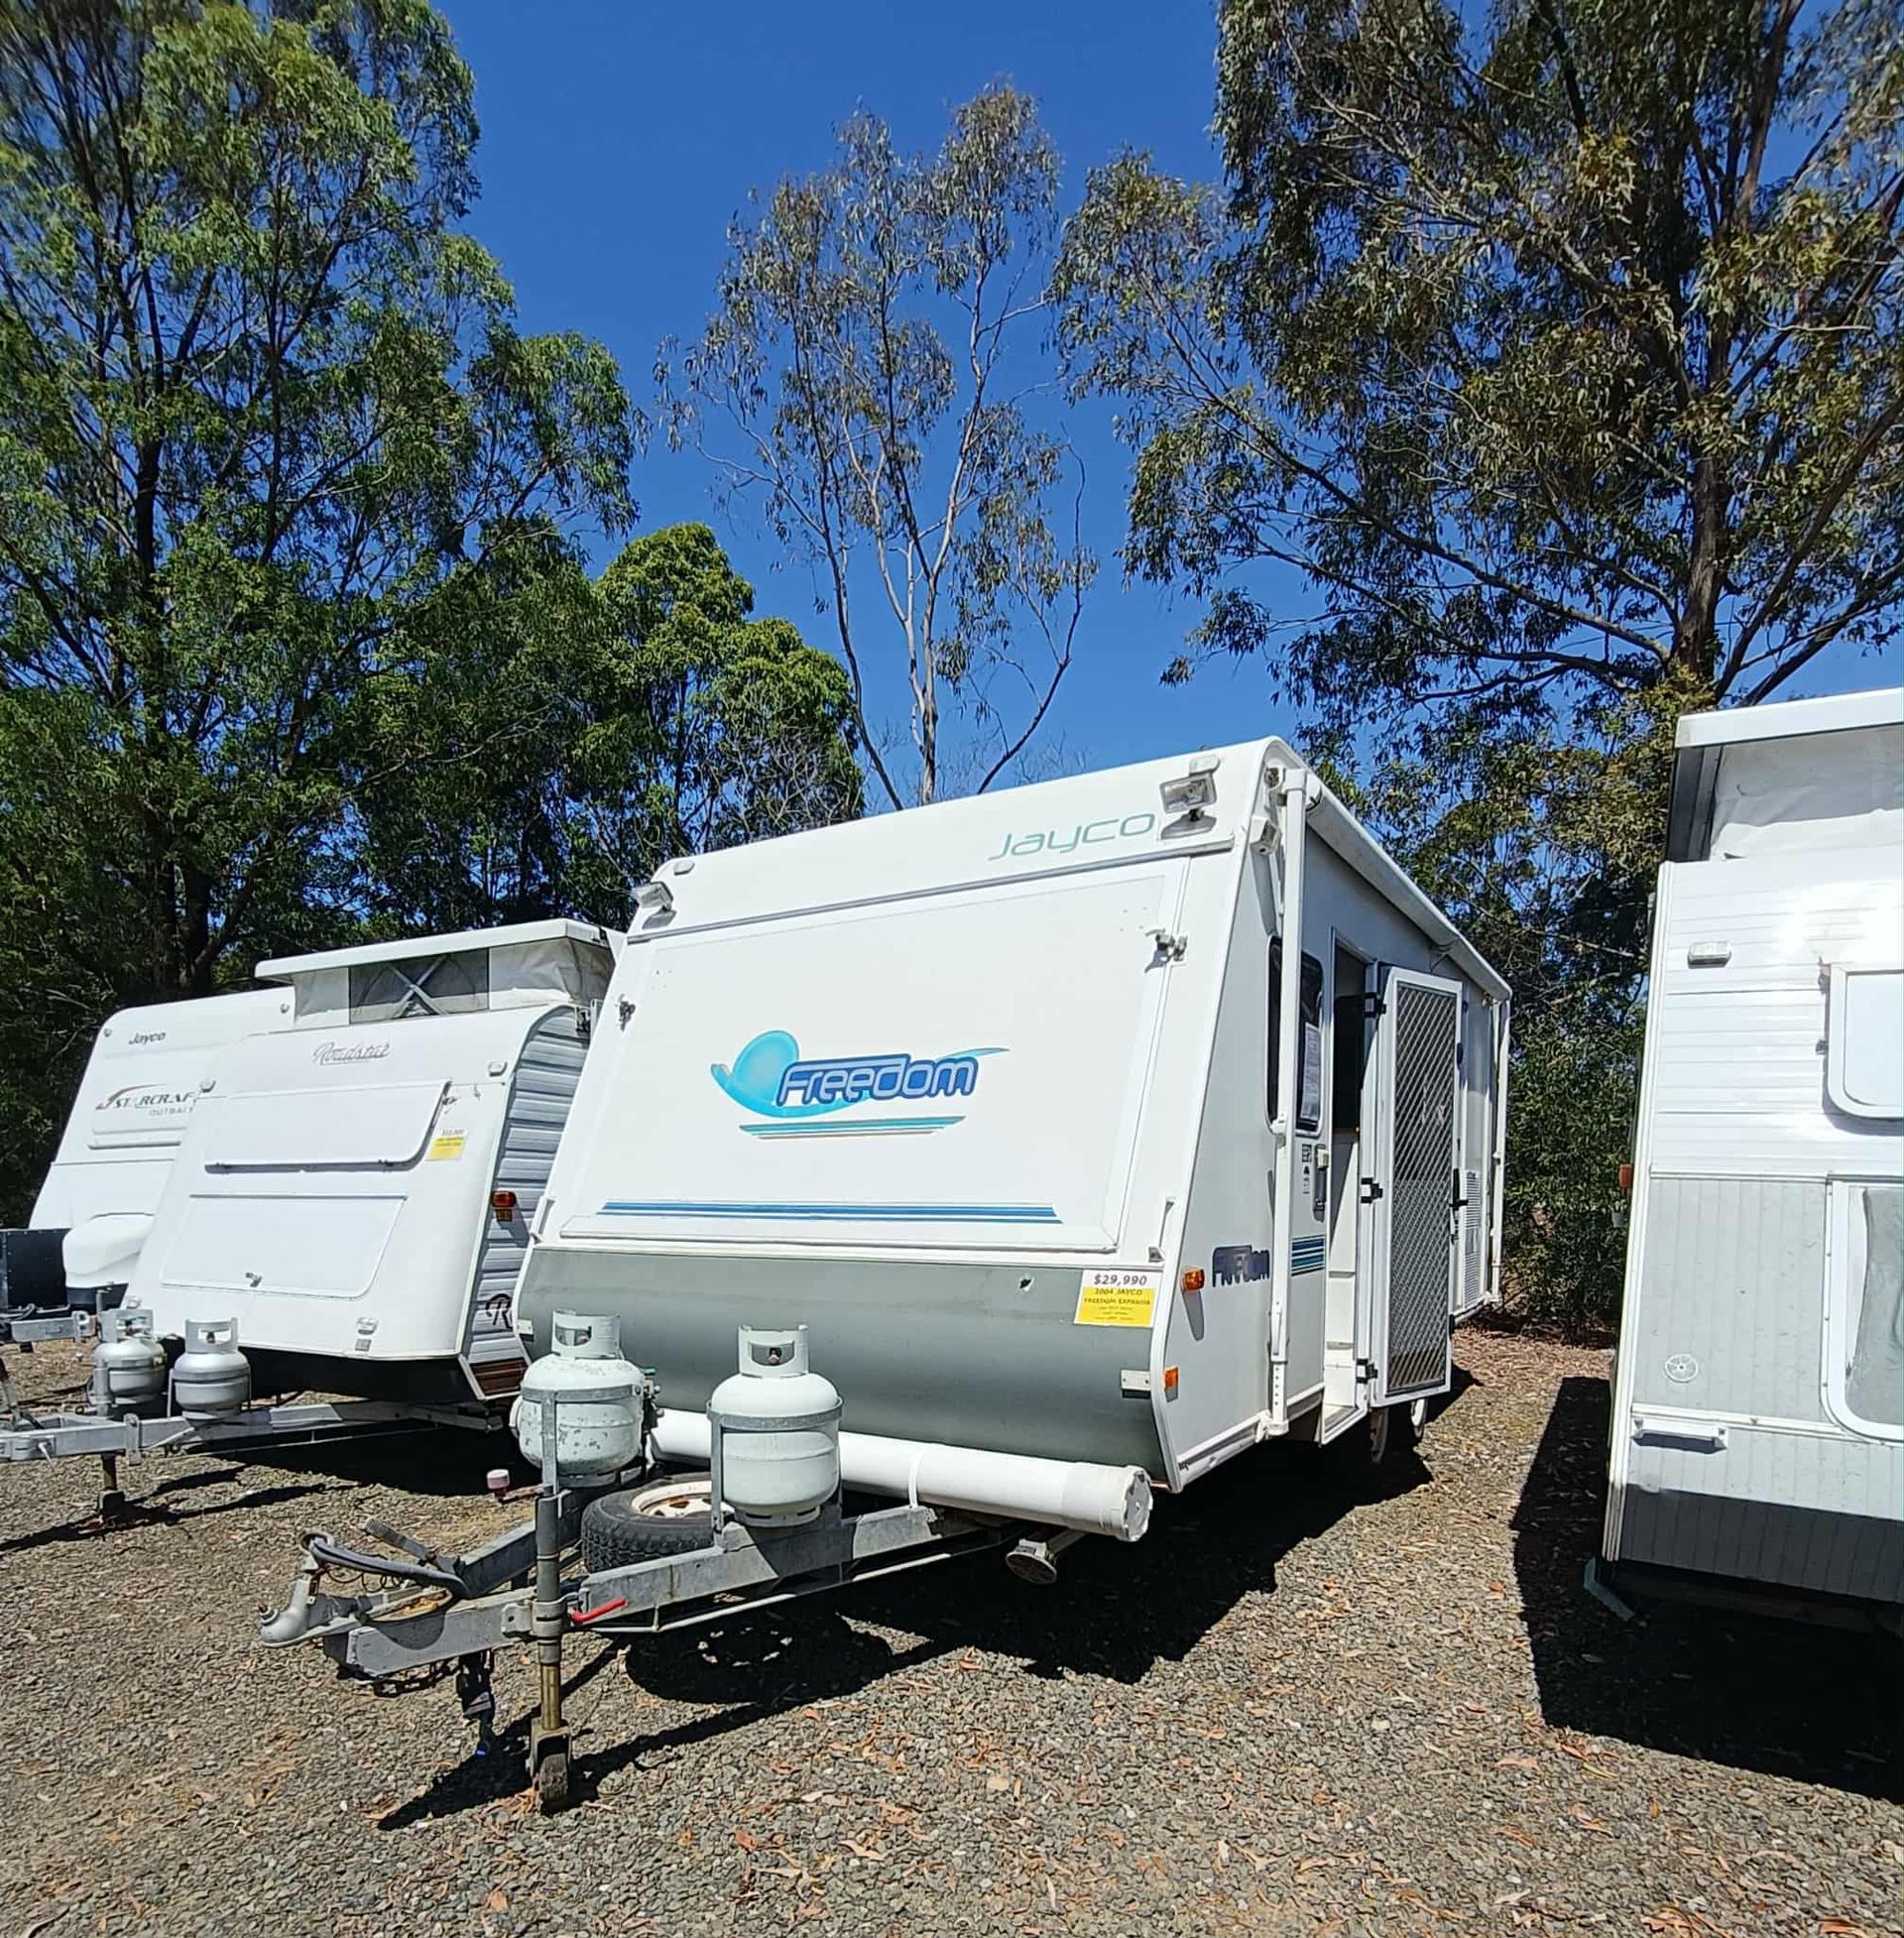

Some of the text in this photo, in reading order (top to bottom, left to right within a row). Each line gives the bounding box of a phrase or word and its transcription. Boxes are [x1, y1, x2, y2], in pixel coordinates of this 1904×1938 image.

[988, 813, 1156, 861] Jayco
[129, 1031, 167, 1044] Jayco
[113, 1093, 196, 1109] STARCRAF
[1094, 1273, 1147, 1286] $29,990
